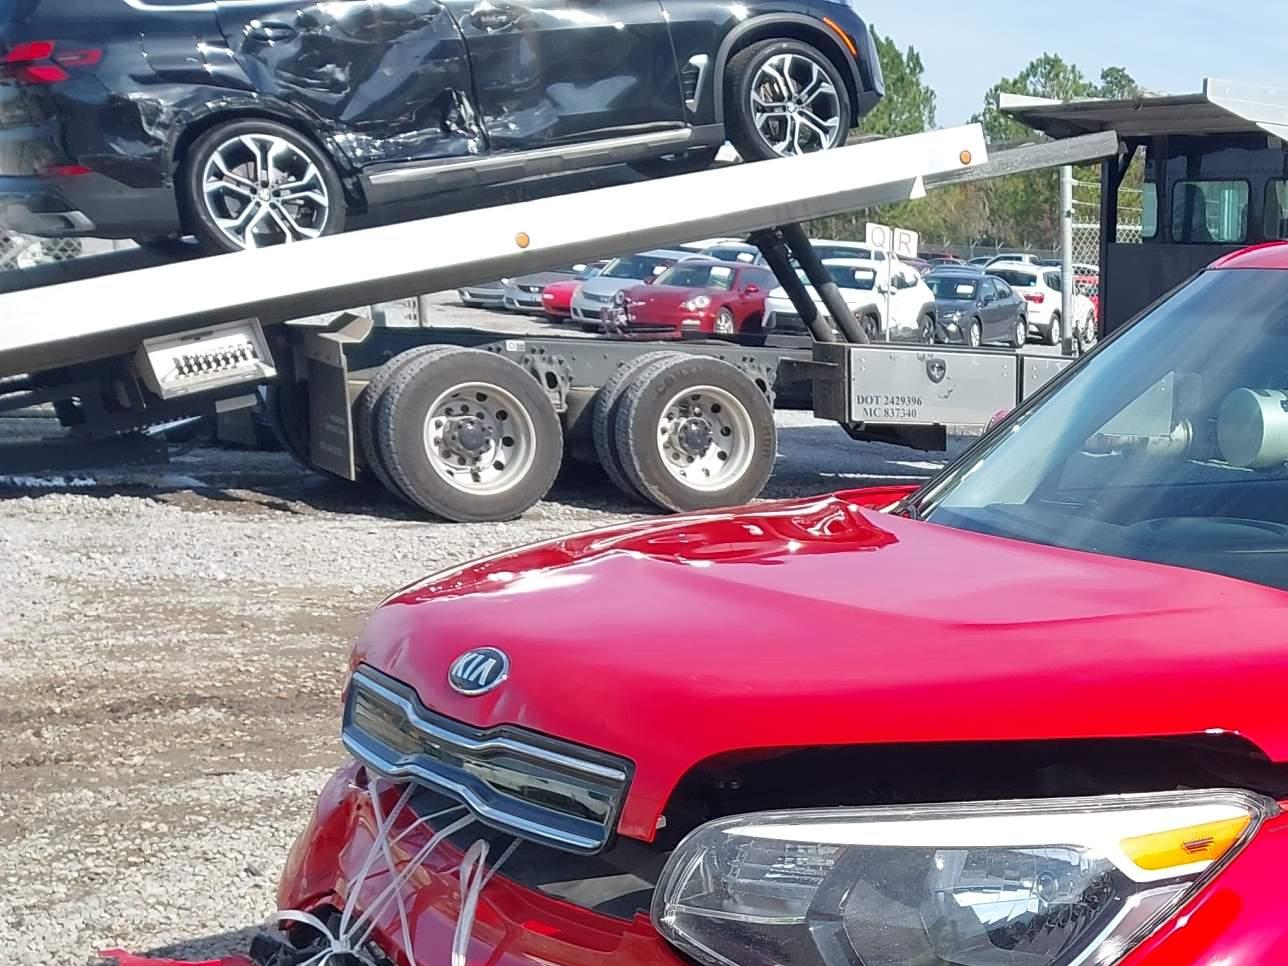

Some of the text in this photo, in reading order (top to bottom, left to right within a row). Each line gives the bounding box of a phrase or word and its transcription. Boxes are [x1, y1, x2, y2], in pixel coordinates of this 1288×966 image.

[871, 226, 886, 249] Q
[898, 231, 912, 254] R
[857, 395, 923, 406] DOT 2429396
[862, 407, 881, 418] MC
[452, 652, 497, 686] KIA
